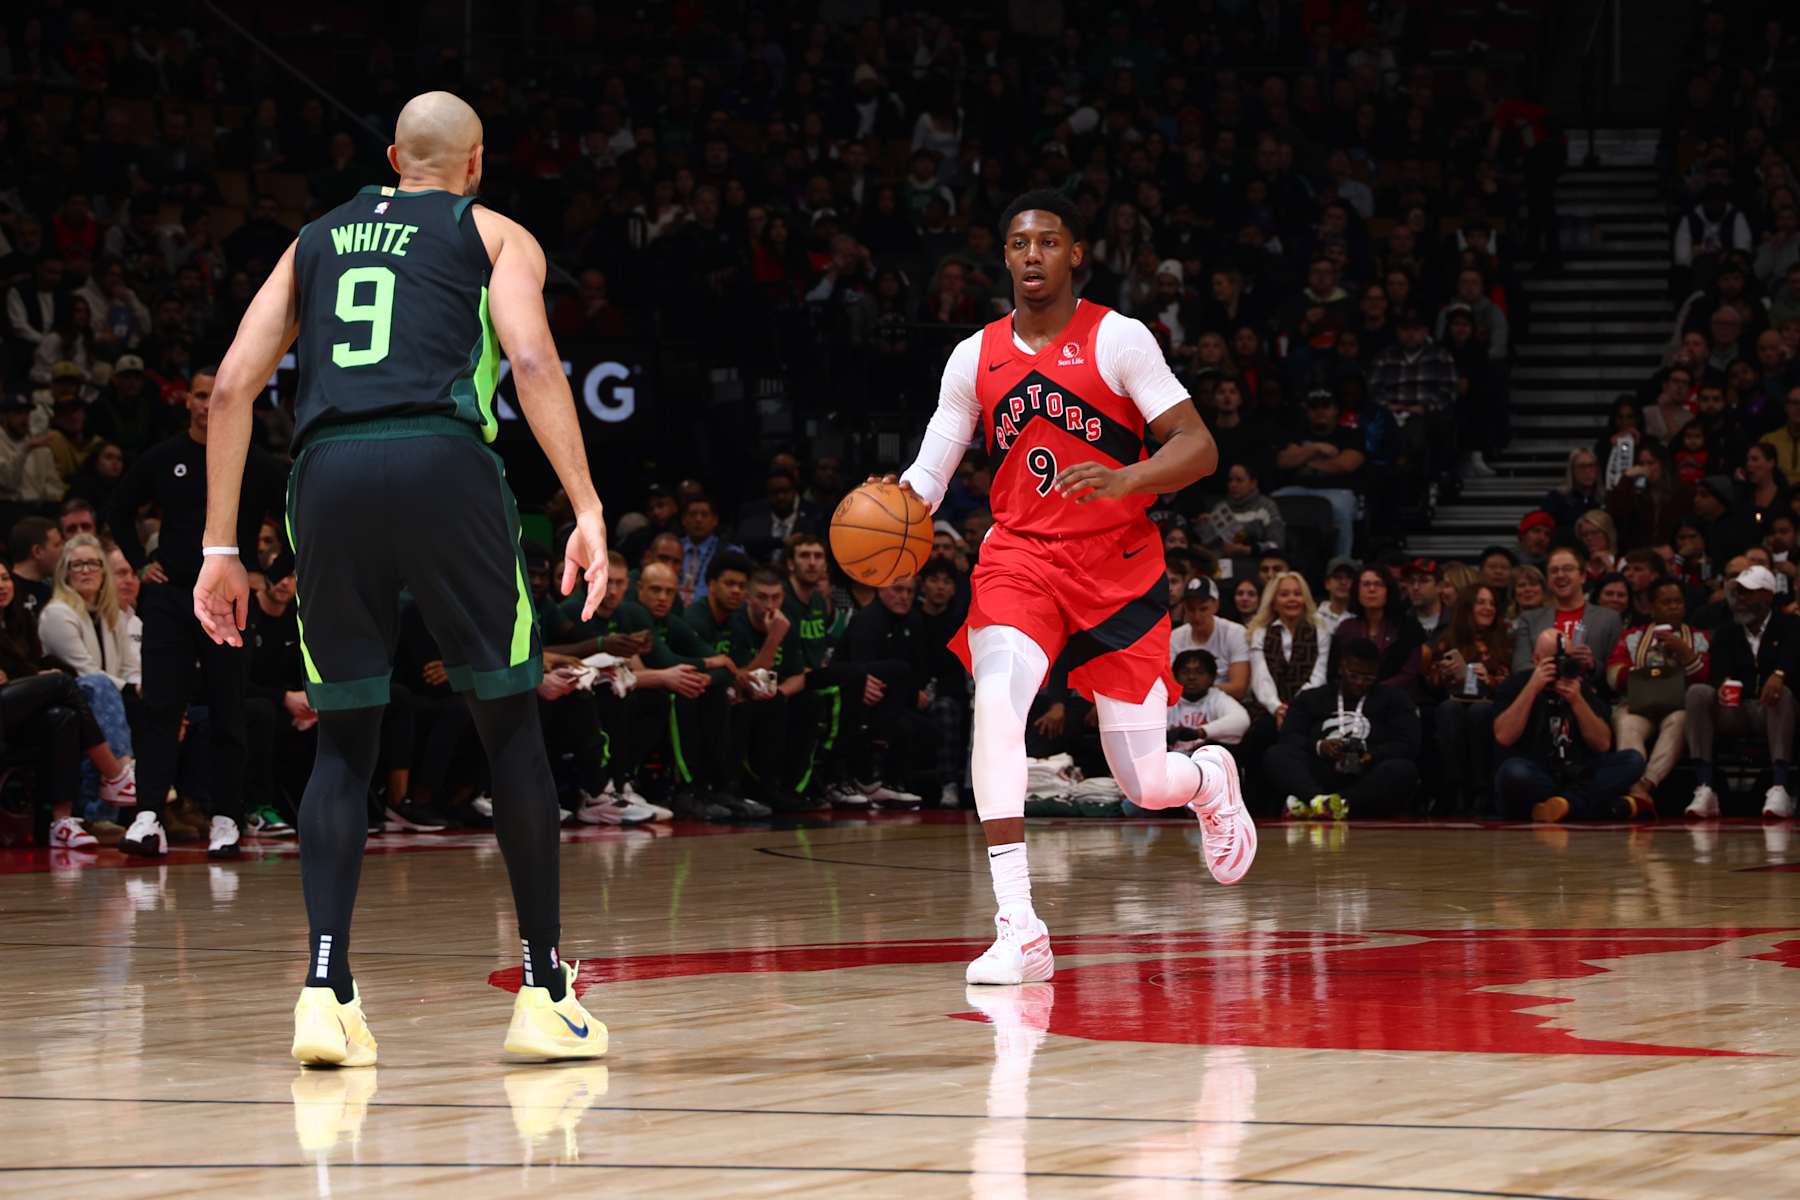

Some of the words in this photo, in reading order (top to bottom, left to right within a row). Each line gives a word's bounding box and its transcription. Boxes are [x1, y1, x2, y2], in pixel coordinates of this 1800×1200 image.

[330, 222, 419, 257] WHITE
[331, 266, 397, 369] 9
[1057, 359, 1071, 367] Sun
[1071, 357, 1085, 366] Life
[995, 384, 1103, 450] RAPTORS
[1026, 446, 1058, 498] 9
